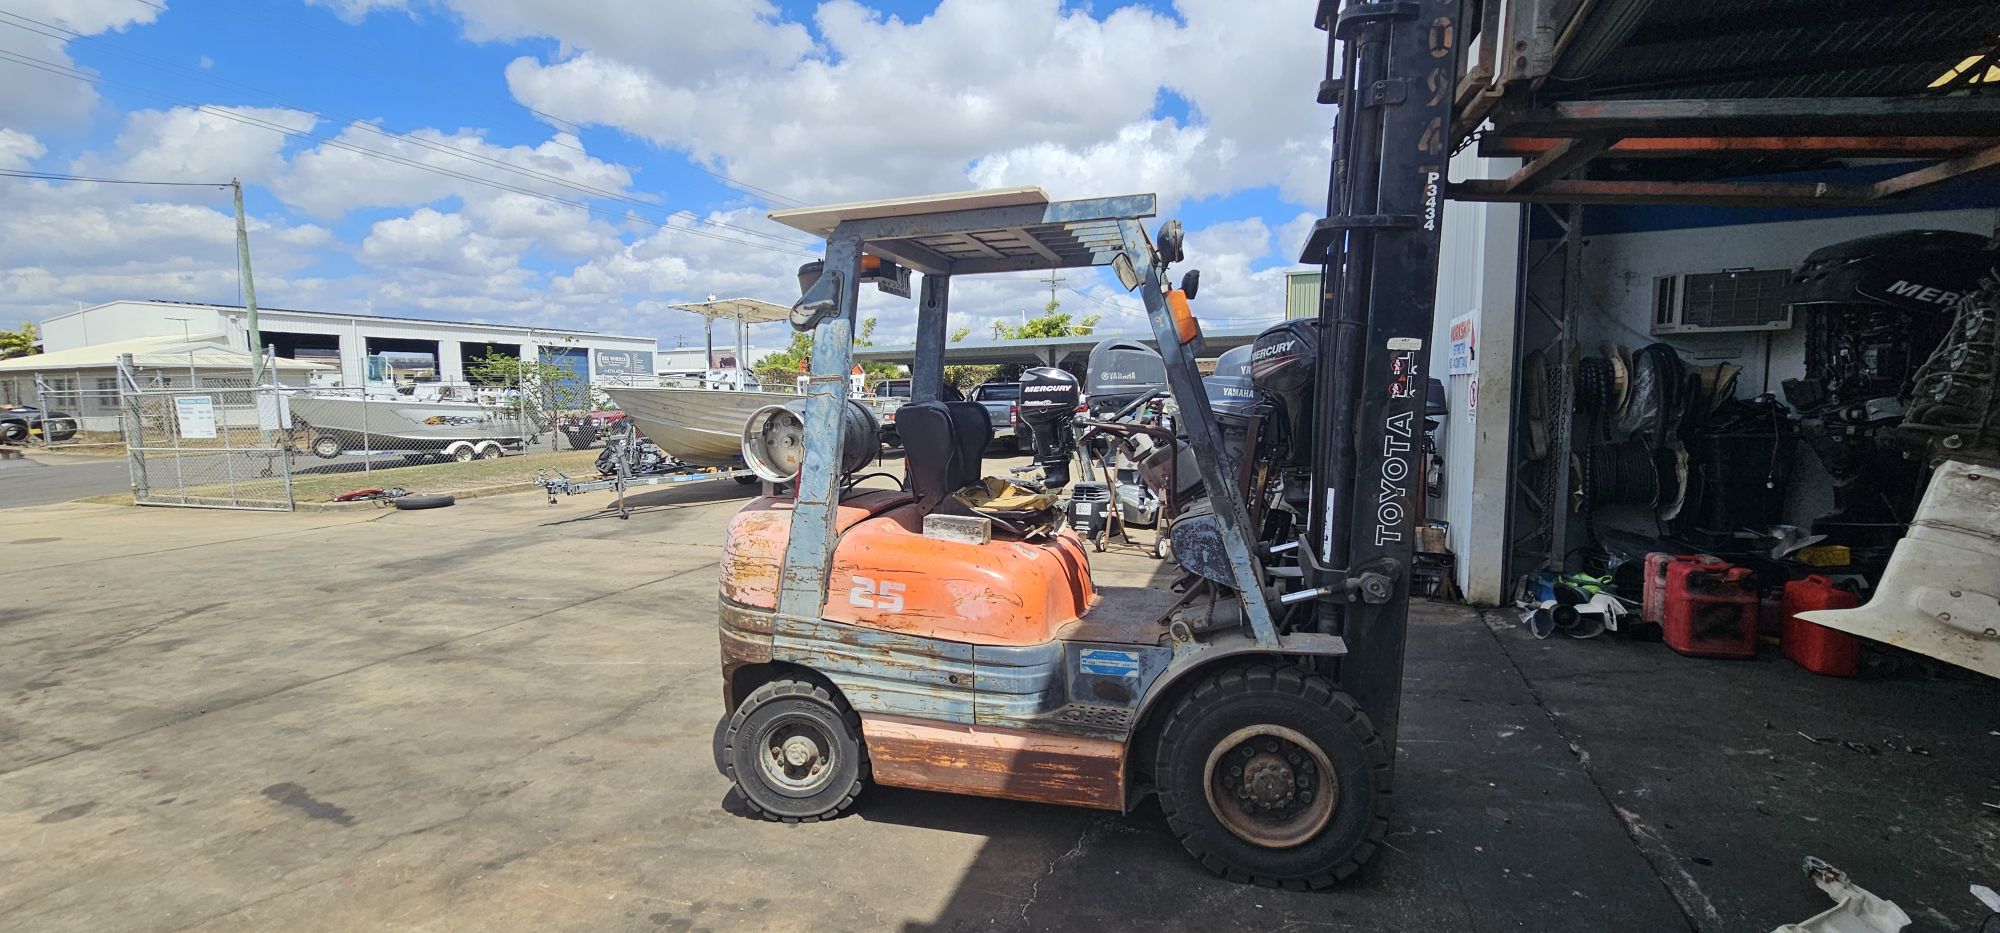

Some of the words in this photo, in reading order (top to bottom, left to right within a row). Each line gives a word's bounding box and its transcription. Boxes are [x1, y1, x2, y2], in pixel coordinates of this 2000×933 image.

[1423, 171, 1440, 231] P3434
[1109, 371, 1136, 380] YAMAHA
[1024, 385, 1072, 393] MERCURY
[1223, 387, 1254, 398] YAMAHA
[1375, 411, 1413, 546] TOYOTA
[849, 575, 906, 613] 25
